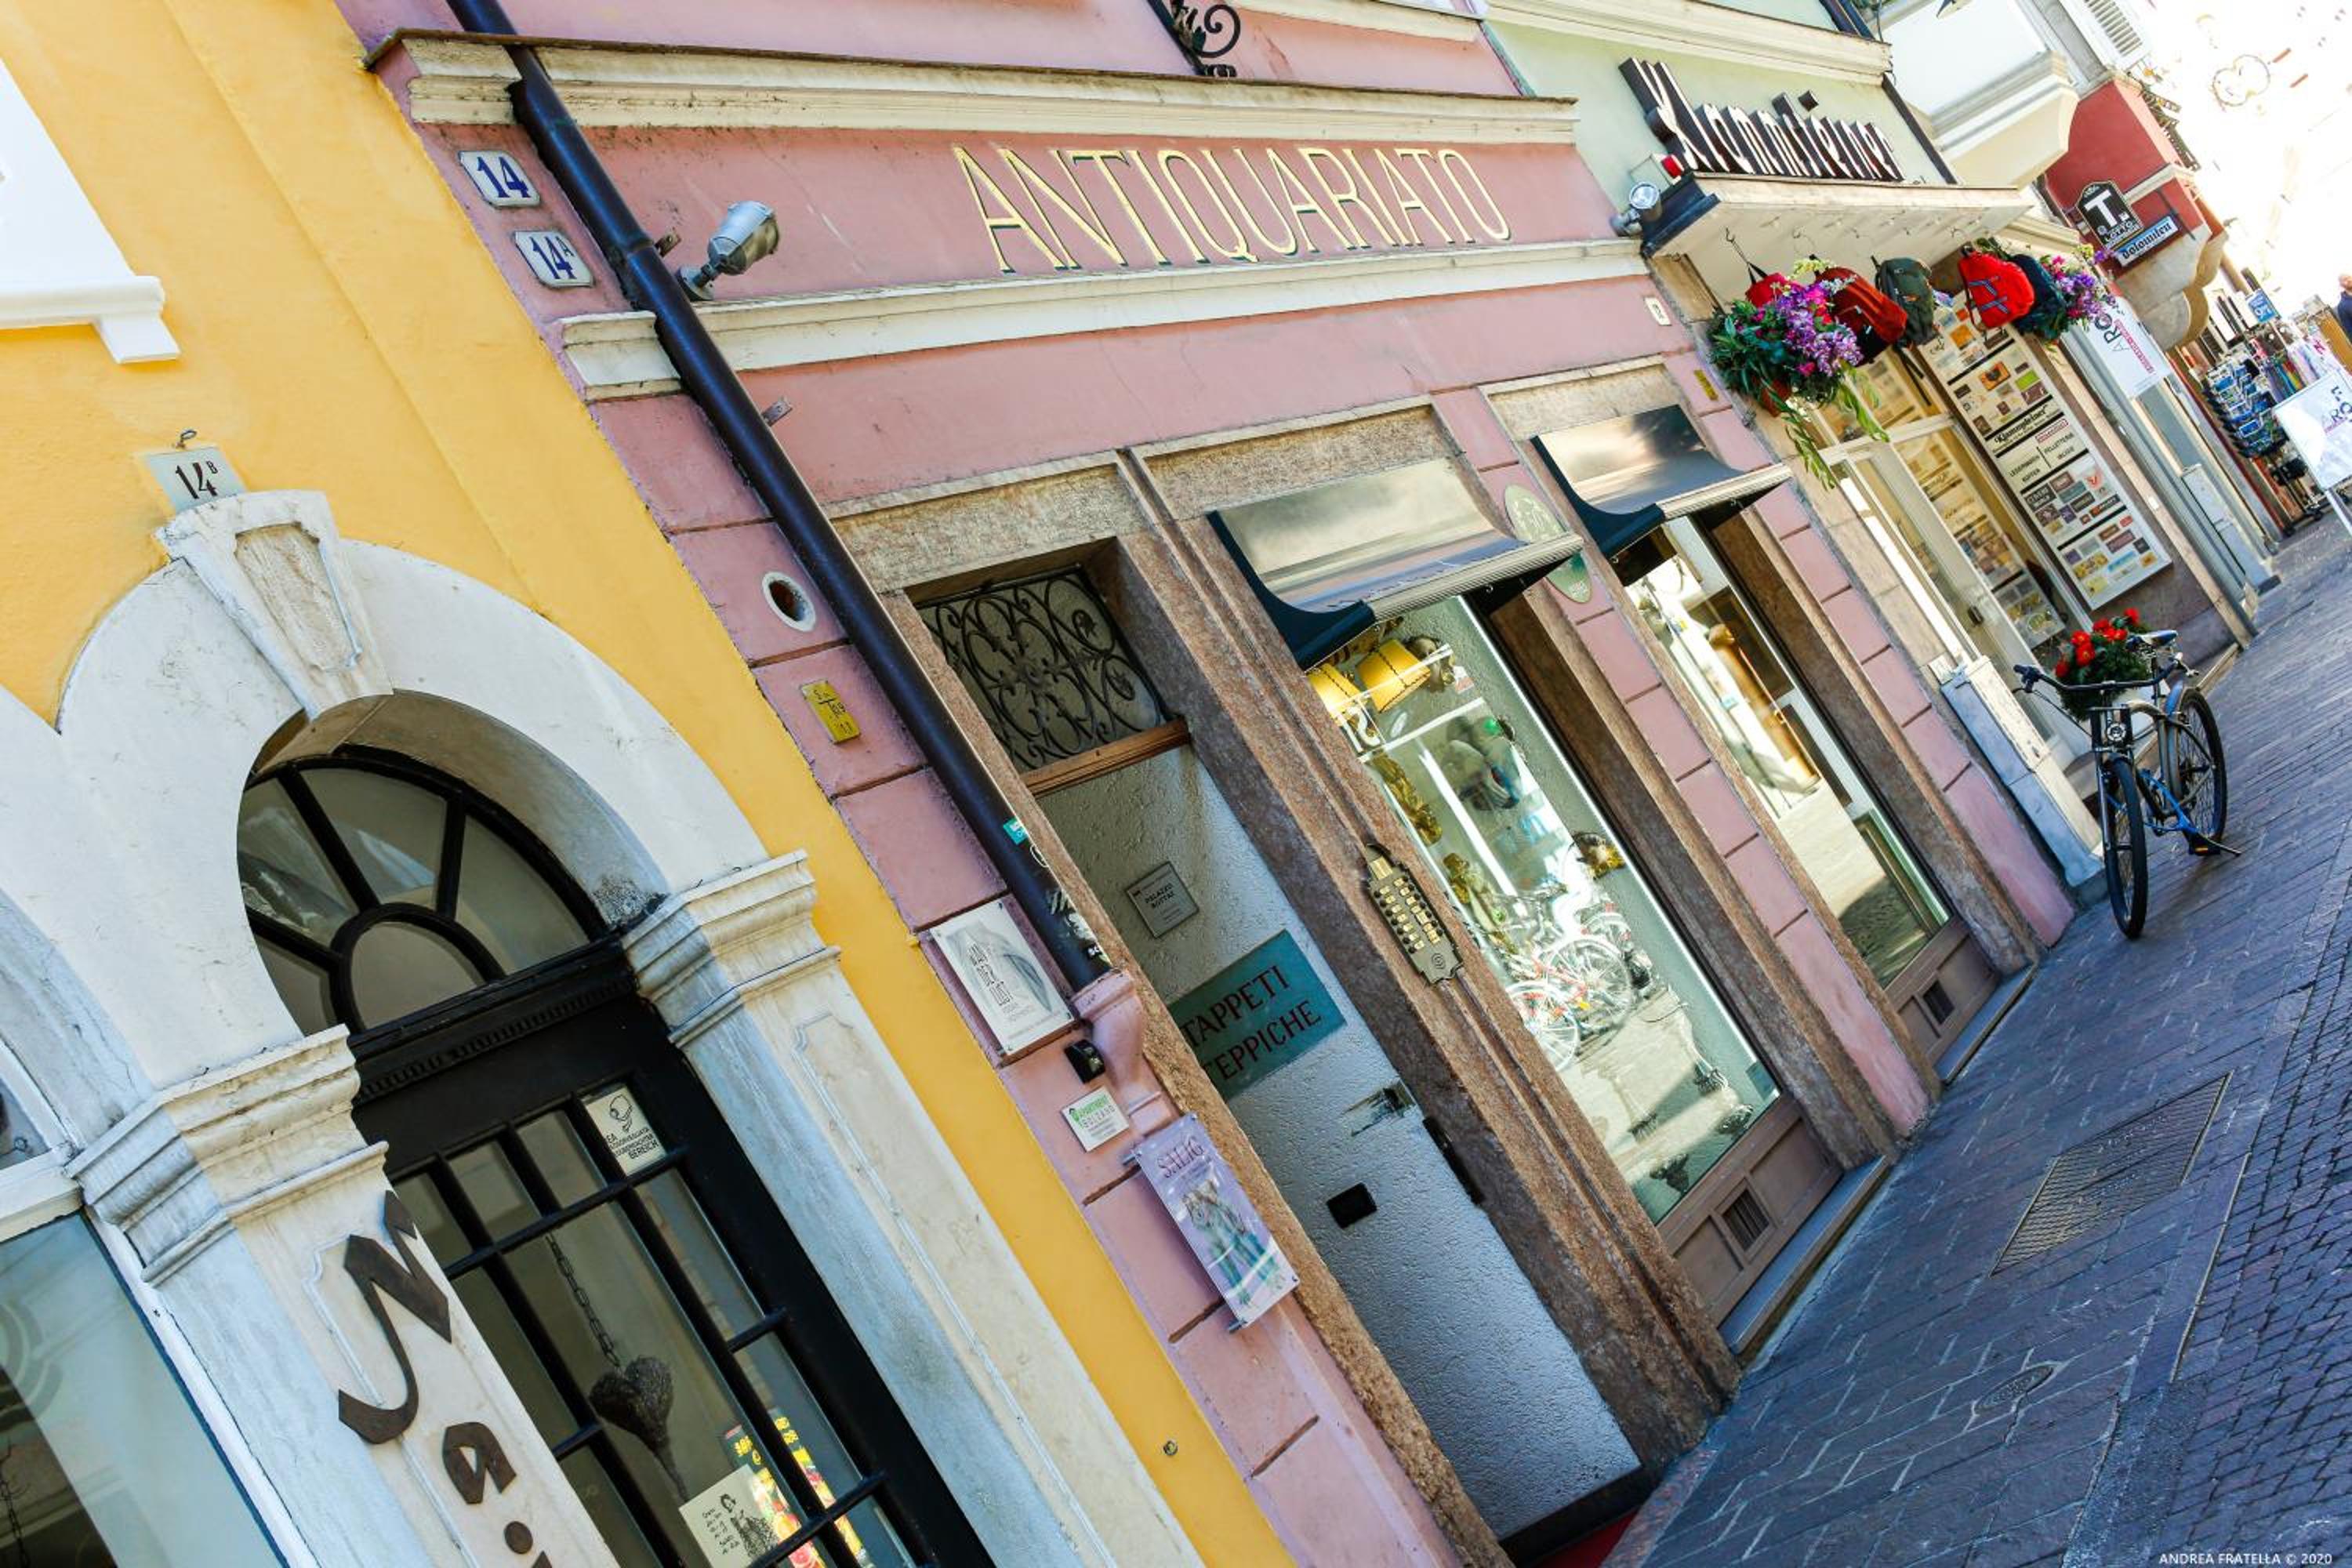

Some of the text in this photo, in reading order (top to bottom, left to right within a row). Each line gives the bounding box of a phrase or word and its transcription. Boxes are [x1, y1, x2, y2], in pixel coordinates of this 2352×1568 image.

[477, 156, 532, 198] 14
[952, 146, 1512, 273] ANTIQUARIATO
[1181, 965, 1291, 1048] TAPPETI
